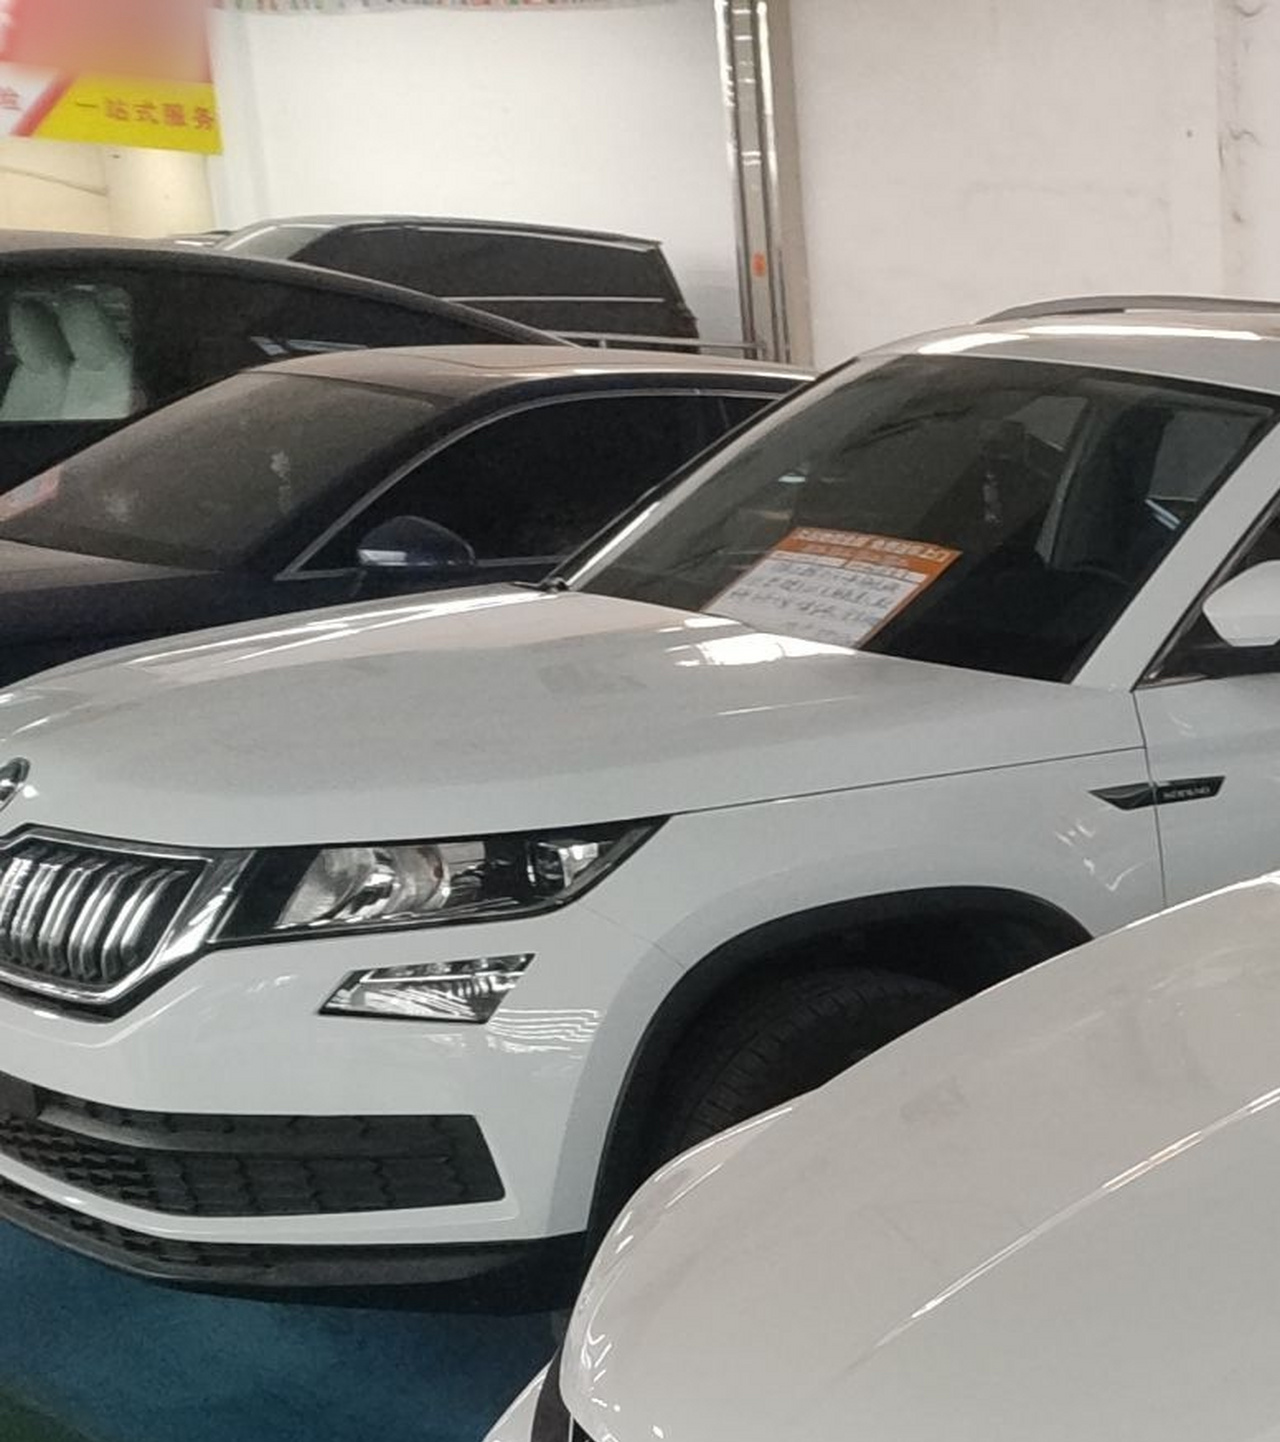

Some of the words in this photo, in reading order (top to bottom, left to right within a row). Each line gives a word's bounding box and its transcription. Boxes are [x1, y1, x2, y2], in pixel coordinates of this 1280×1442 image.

[75, 96, 214, 131] 一站式服务
